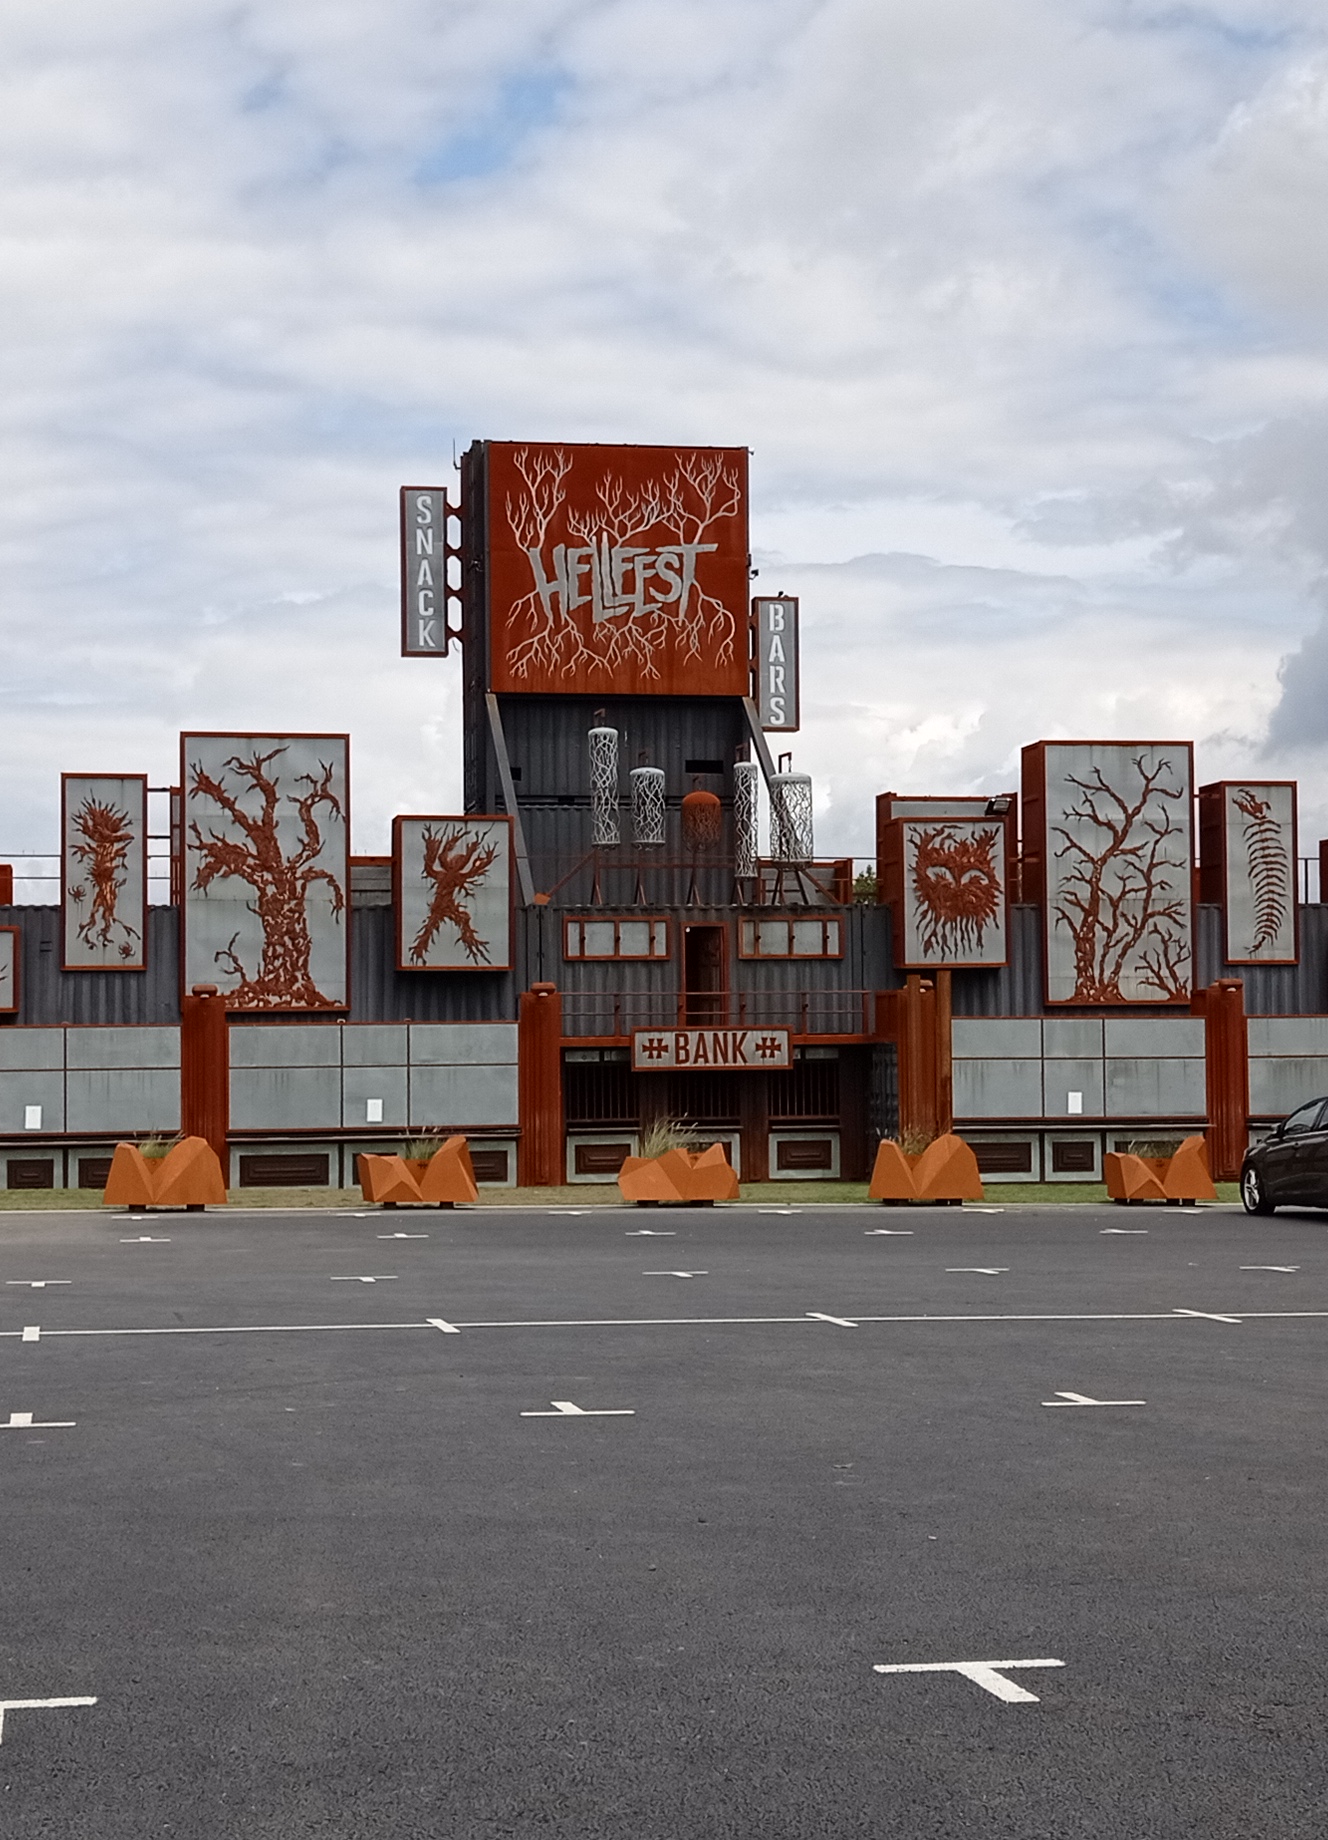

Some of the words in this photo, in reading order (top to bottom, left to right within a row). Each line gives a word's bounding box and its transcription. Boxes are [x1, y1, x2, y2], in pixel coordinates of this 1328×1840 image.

[416, 495, 436, 648] SNACK
[528, 531, 719, 626] HELLFEST
[768, 603, 786, 725] BARS
[674, 1032, 749, 1065] BANK
